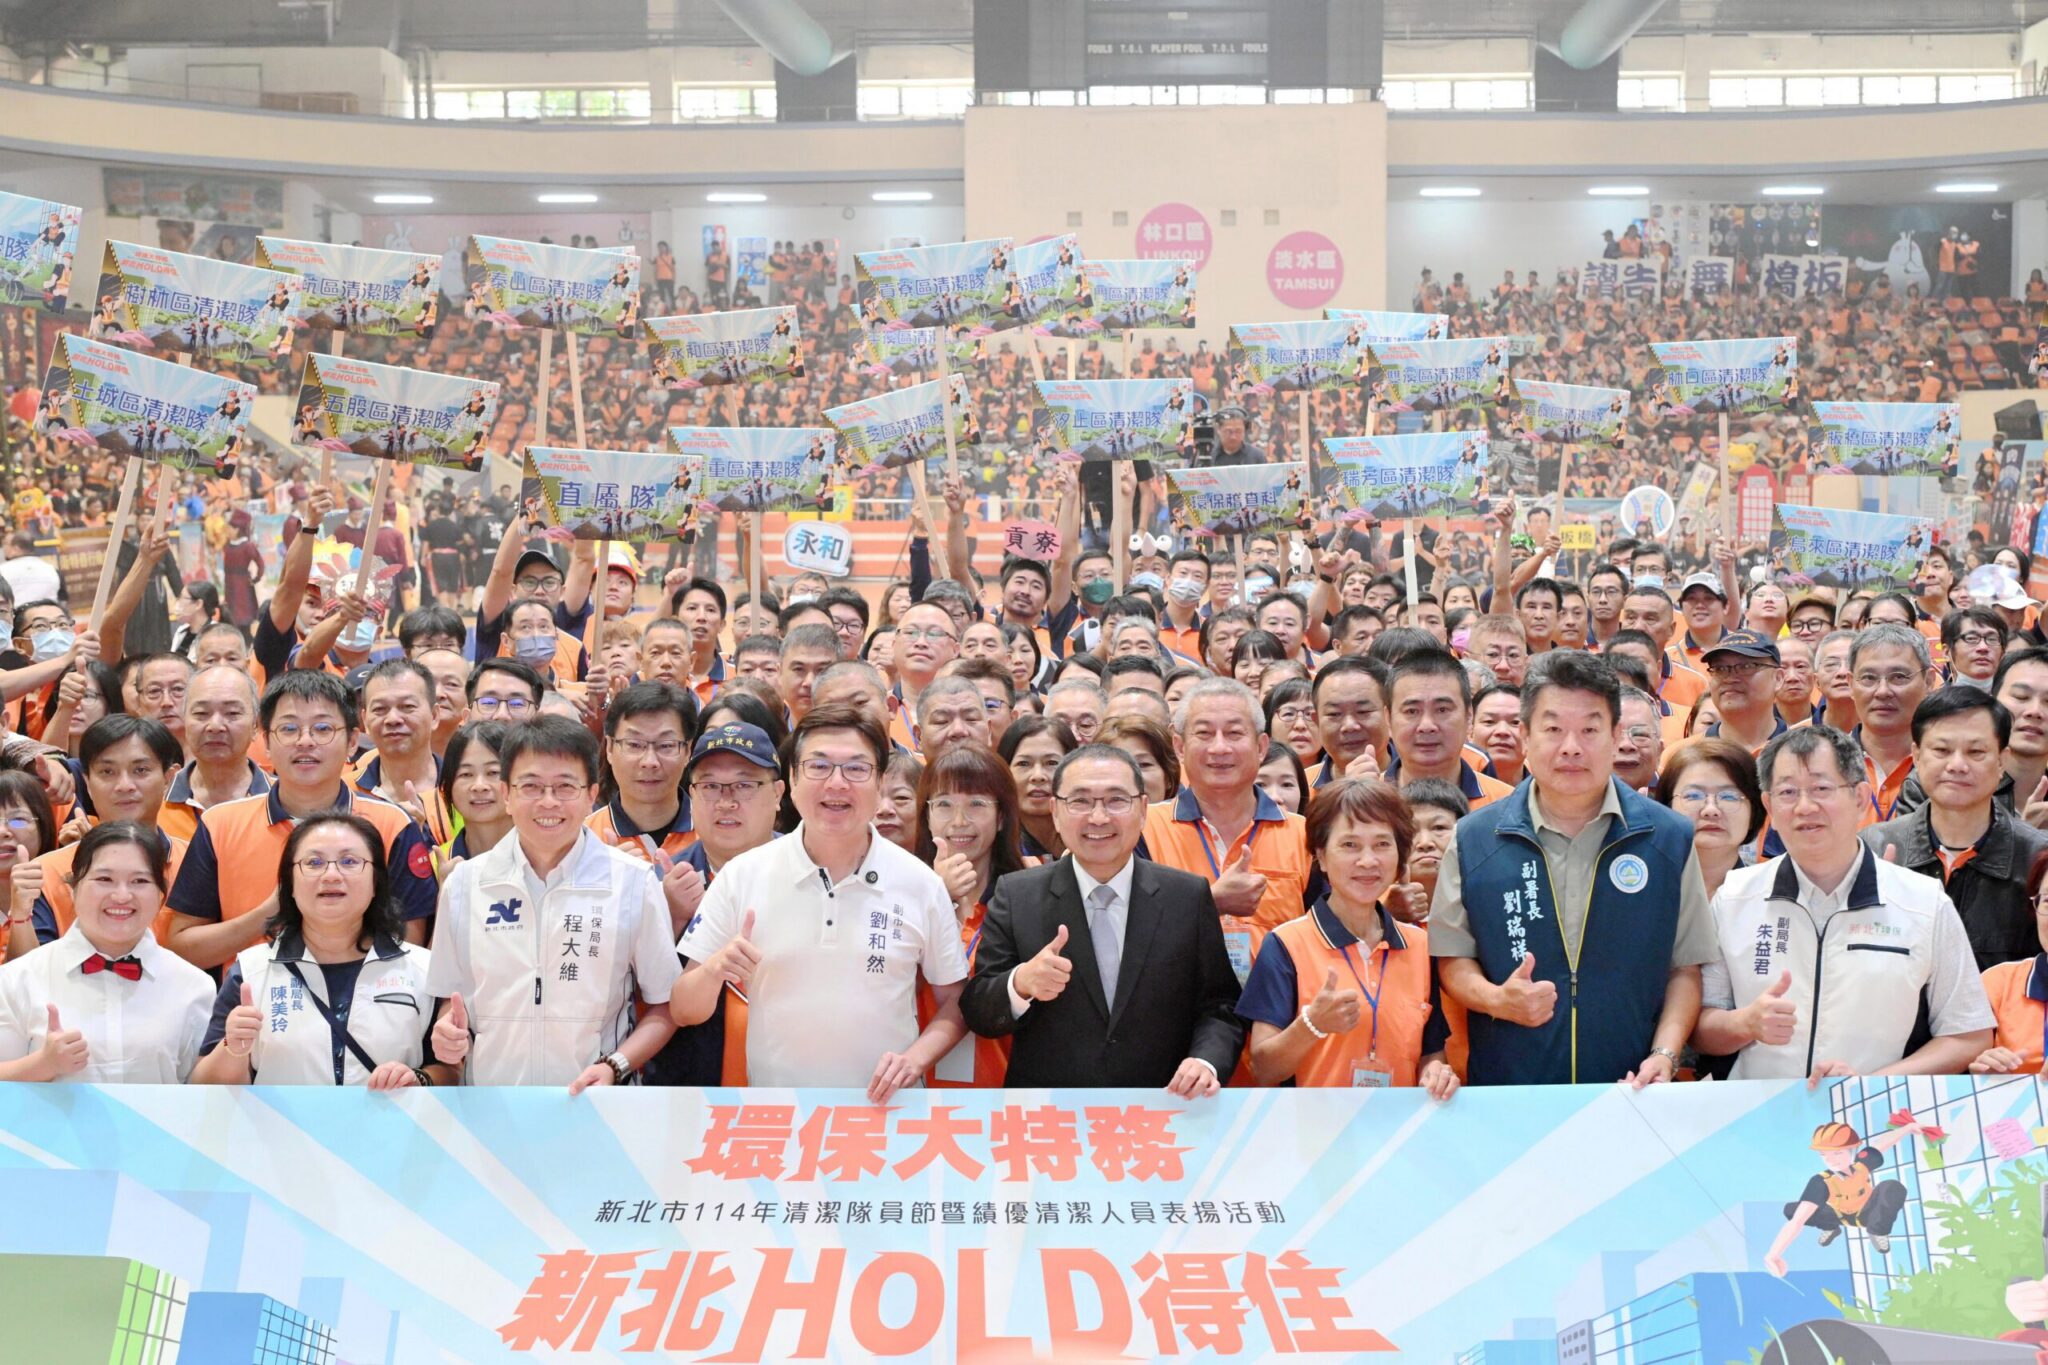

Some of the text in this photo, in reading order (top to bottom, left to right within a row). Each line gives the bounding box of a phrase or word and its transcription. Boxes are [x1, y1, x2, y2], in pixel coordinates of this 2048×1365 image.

[1088, 44, 1112, 54] FOULS
[1151, 44, 1181, 54] PLAYER
[1183, 44, 1204, 54] FOUL
[1243, 43, 1268, 53] FOULS
[1143, 222, 1205, 242] 林口區
[1274, 250, 1336, 270] 淡水區
[491, 271, 605, 301] 泰山區清潔隊
[1275, 278, 1334, 290] TAMSUI
[125, 283, 259, 325] 樹林區清潔隊
[671, 337, 771, 360] 永和區清潔隊
[1668, 367, 1768, 386] 林口區清潔隊
[73, 381, 208, 431] 土城區清潔隊
[325, 394, 457, 431] 五股區清潔隊
[1055, 410, 1162, 429] 汐止區清潔隊
[850, 410, 944, 449] 三芝區清潔隊
[1827, 430, 1929, 448] 板橋區清潔隊
[701, 459, 801, 479] 重區清潔隊
[1343, 465, 1456, 487] 瑞芳區清潔隊
[557, 480, 656, 510] 直屬隊
[793, 529, 843, 560] 永和
[1005, 526, 1059, 554] 貢寮
[1560, 530, 1594, 546] 板橋
[1791, 536, 1897, 561] 烏來區清潔隊
[707, 737, 753, 750] 新北市政府
[1521, 860, 1544, 921] 副署長
[588, 905, 603, 958] 環保局長
[892, 903, 904, 941] 副市長
[1503, 890, 1528, 962] 劉瑞祥
[1775, 916, 1790, 954] 副局長
[559, 914, 583, 981] 程大維
[867, 911, 888, 974] 劉和然
[1753, 923, 1773, 976] 朱益君
[270, 985, 288, 1034] 陳美玲
[682, 1104, 1195, 1182] 環保大特務
[595, 1200, 1288, 1226] 新北市114年清潔隊員節暨績優清潔人員表揚活動
[495, 1247, 1405, 1364] 新北HOLD得住
